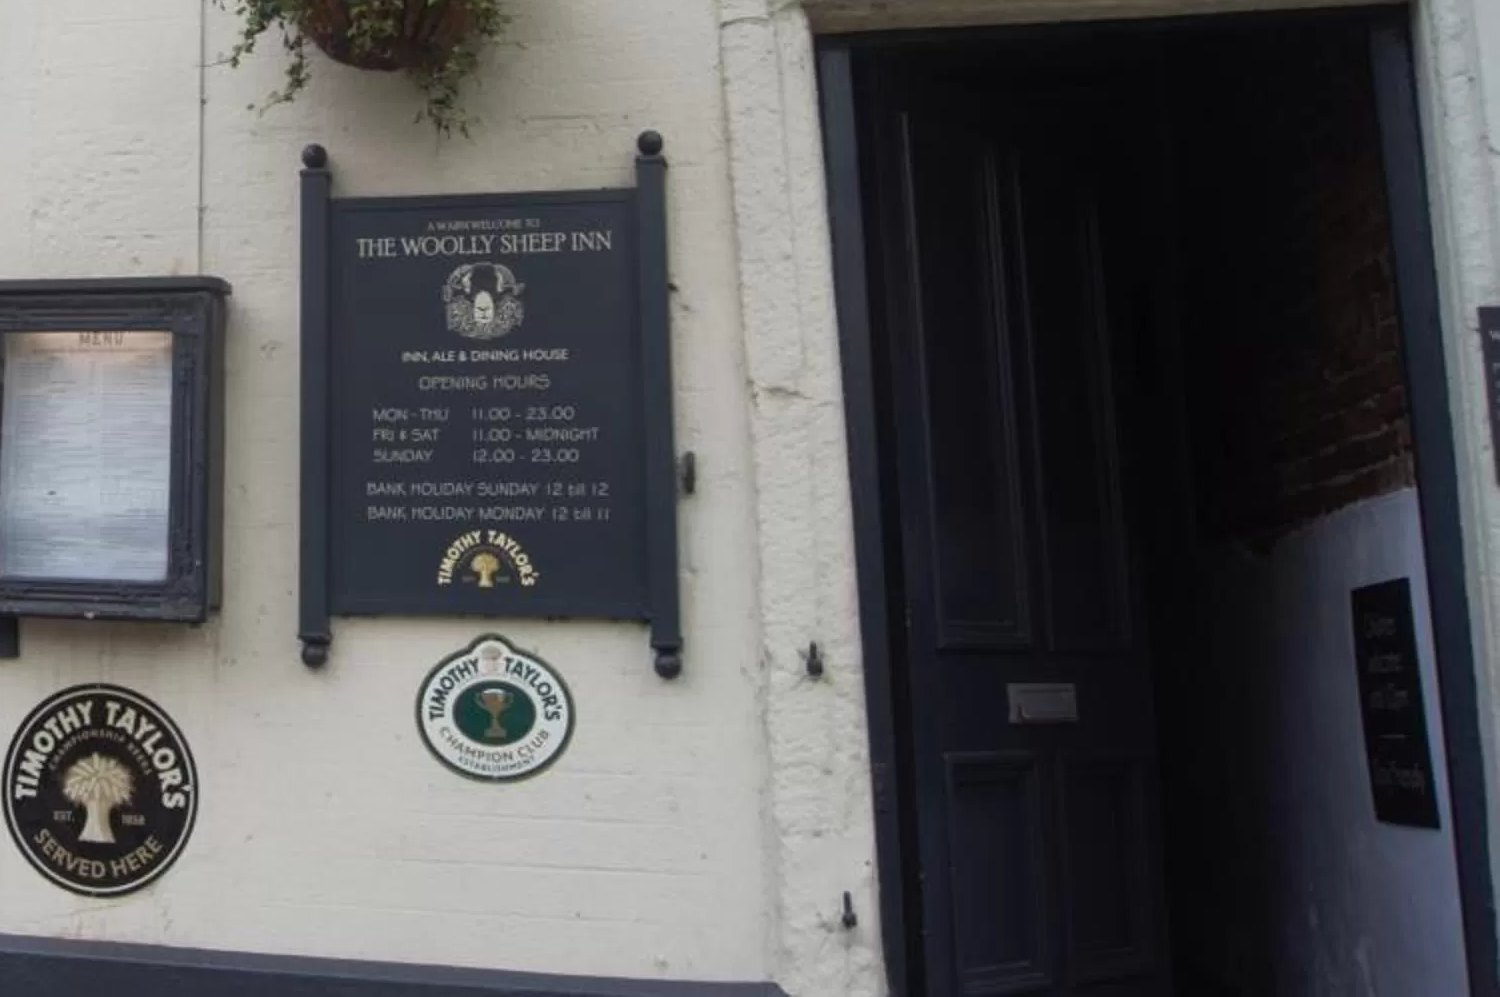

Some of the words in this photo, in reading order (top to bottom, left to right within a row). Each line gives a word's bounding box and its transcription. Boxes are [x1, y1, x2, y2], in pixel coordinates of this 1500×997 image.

[356, 237, 397, 258] THE
[400, 234, 497, 256] WOOLLY
[500, 232, 567, 254] SHEEP
[571, 230, 612, 252] INN
[432, 350, 455, 363] ALE
[471, 349, 520, 363] DINING
[523, 348, 570, 362] HOUSE
[419, 374, 488, 391] OPENING
[493, 373, 551, 391] HOURS
[372, 408, 408, 421] MON
[419, 407, 449, 421] THU
[472, 407, 512, 421] 11.00
[525, 405, 576, 421] 23.00
[411, 428, 441, 442] SAT
[472, 428, 512, 442] 11.00
[525, 426, 600, 442] MIDNIGHT
[372, 449, 435, 463] SUNDAY
[472, 449, 515, 463] 12.00
[531, 448, 580, 463] 23.00
[366, 482, 407, 497] BANK
[410, 482, 474, 497] HOLIDAY
[477, 482, 539, 497] SUNDAY
[546, 481, 563, 497] 12
[591, 481, 610, 496] 12
[367, 506, 407, 522] BANK
[410, 506, 475, 521] HOLIDAY
[477, 506, 545, 522] MONDAY
[551, 505, 568, 521] 12
[437, 529, 481, 585] TIMOTHY
[487, 529, 540, 586] TAYLOR'S
[428, 657, 479, 723] TIMOTHY
[503, 656, 564, 722] TAYLOR'S
[440, 726, 514, 763] CHAMPION
[516, 730, 550, 761] CLUB
[14, 700, 94, 800] TIMOTHY
[104, 700, 195, 810] TAYLOR'S
[458, 754, 536, 772] ESTABLISHMENT
[32, 828, 106, 879] SERVED
[109, 834, 164, 878] HERE
